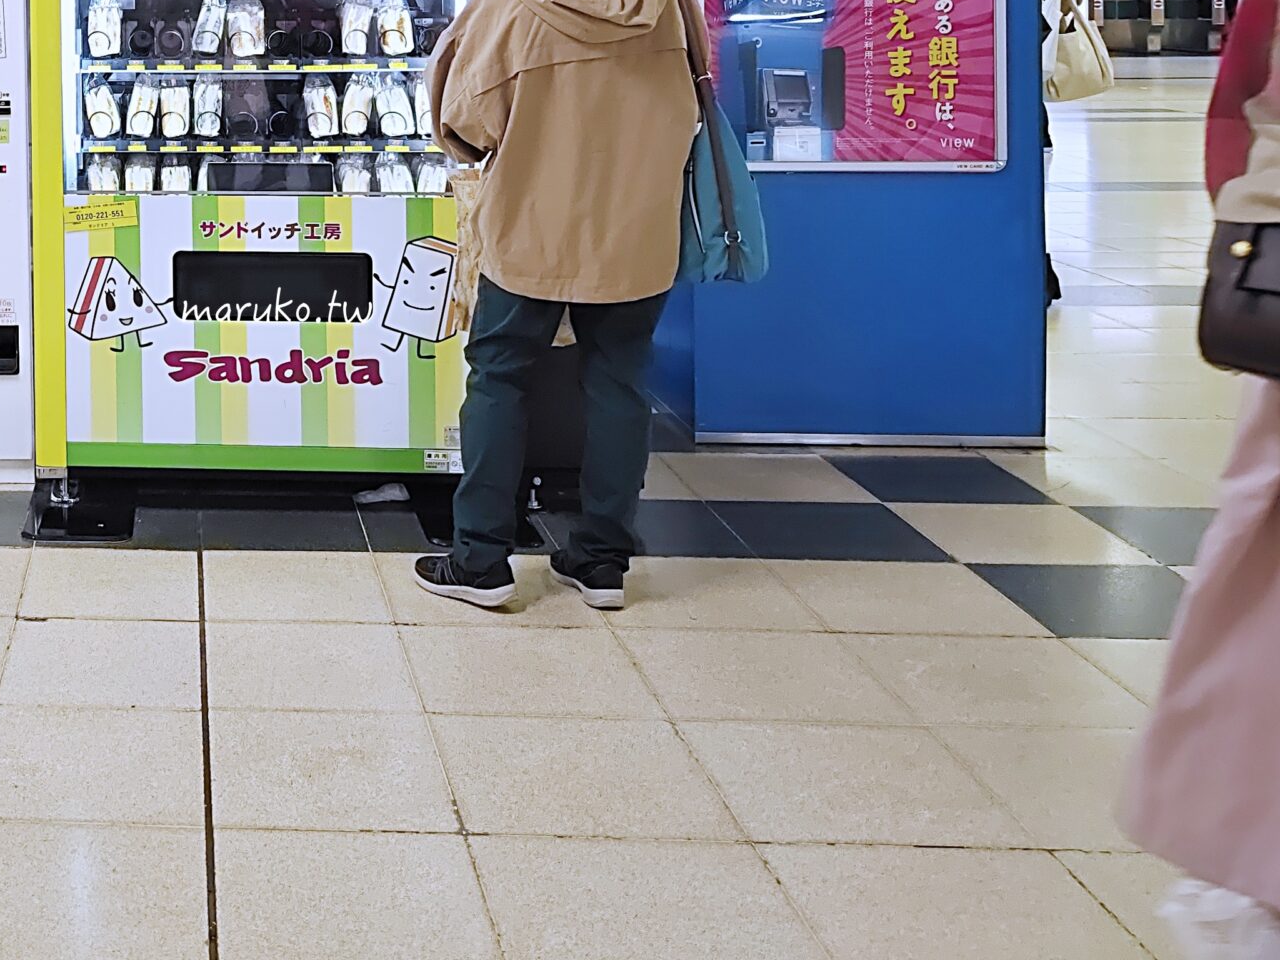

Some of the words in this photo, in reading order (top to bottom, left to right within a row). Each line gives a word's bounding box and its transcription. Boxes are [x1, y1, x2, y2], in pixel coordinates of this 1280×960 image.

[75, 209, 125, 221] 0120-221-551
[199, 220, 343, 241] サンドイッチ工房
[163, 349, 384, 386] Sandria
